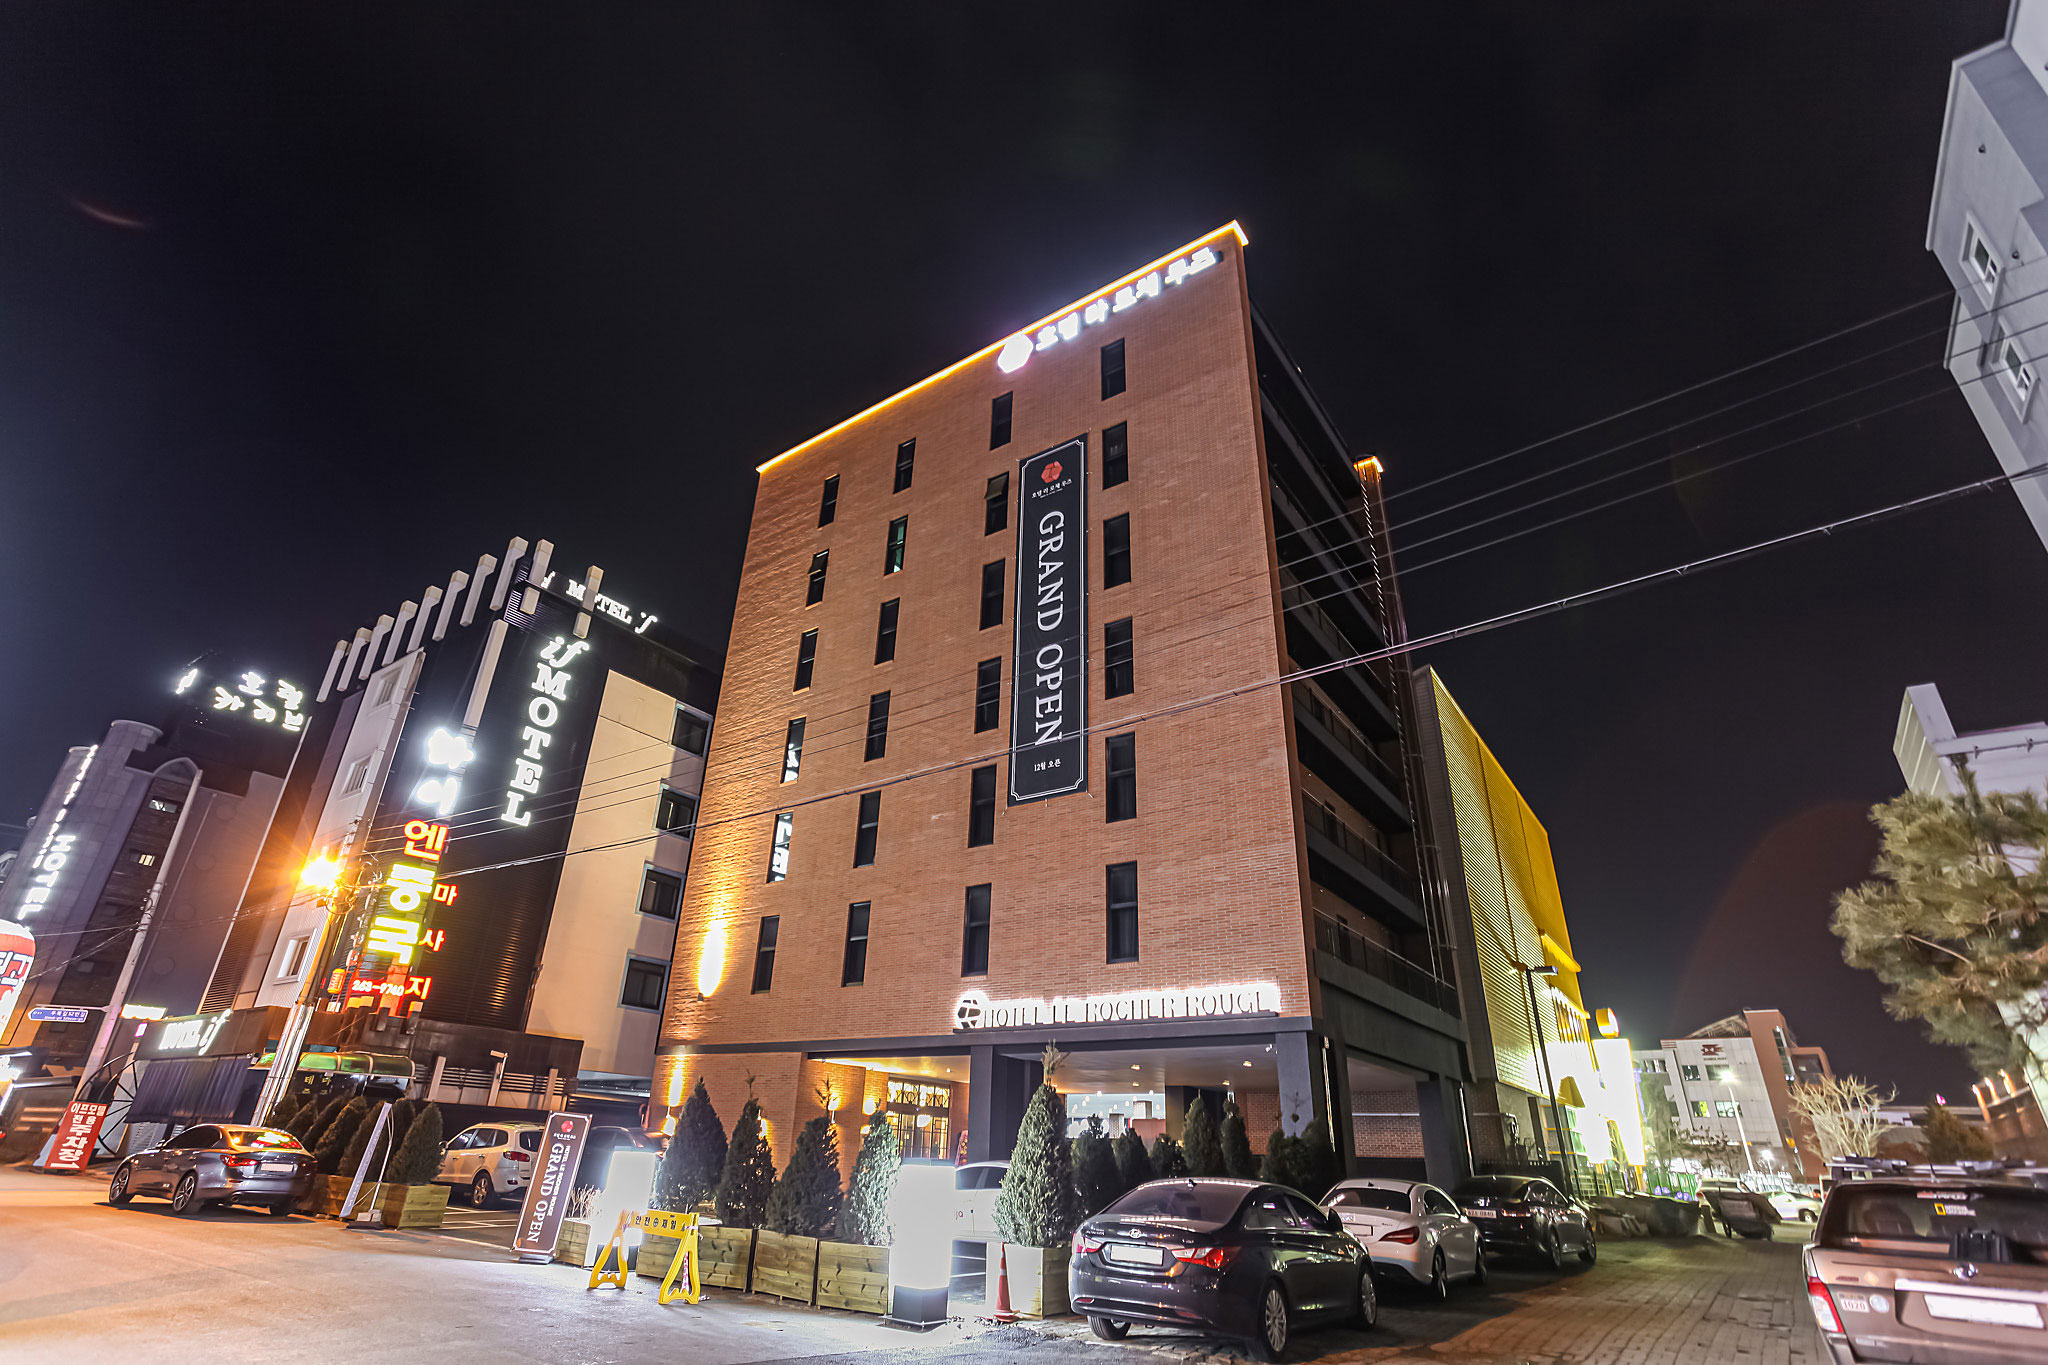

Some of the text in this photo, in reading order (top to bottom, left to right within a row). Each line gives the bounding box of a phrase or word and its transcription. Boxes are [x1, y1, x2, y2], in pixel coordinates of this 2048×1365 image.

[565, 578, 633, 625] MTEL
[1037, 510, 1066, 632] GRAND
[540, 636, 590, 668] if
[1034, 642, 1064, 748] OPEN
[500, 662, 572, 828] MOTEL
[16, 834, 77, 921] HOTEL
[405, 883, 459, 1001] 마사지
[58, 1123, 92, 1162] 주차장
[540, 1142, 565, 1197] GRAND
[526, 1200, 548, 1244] OPEN
